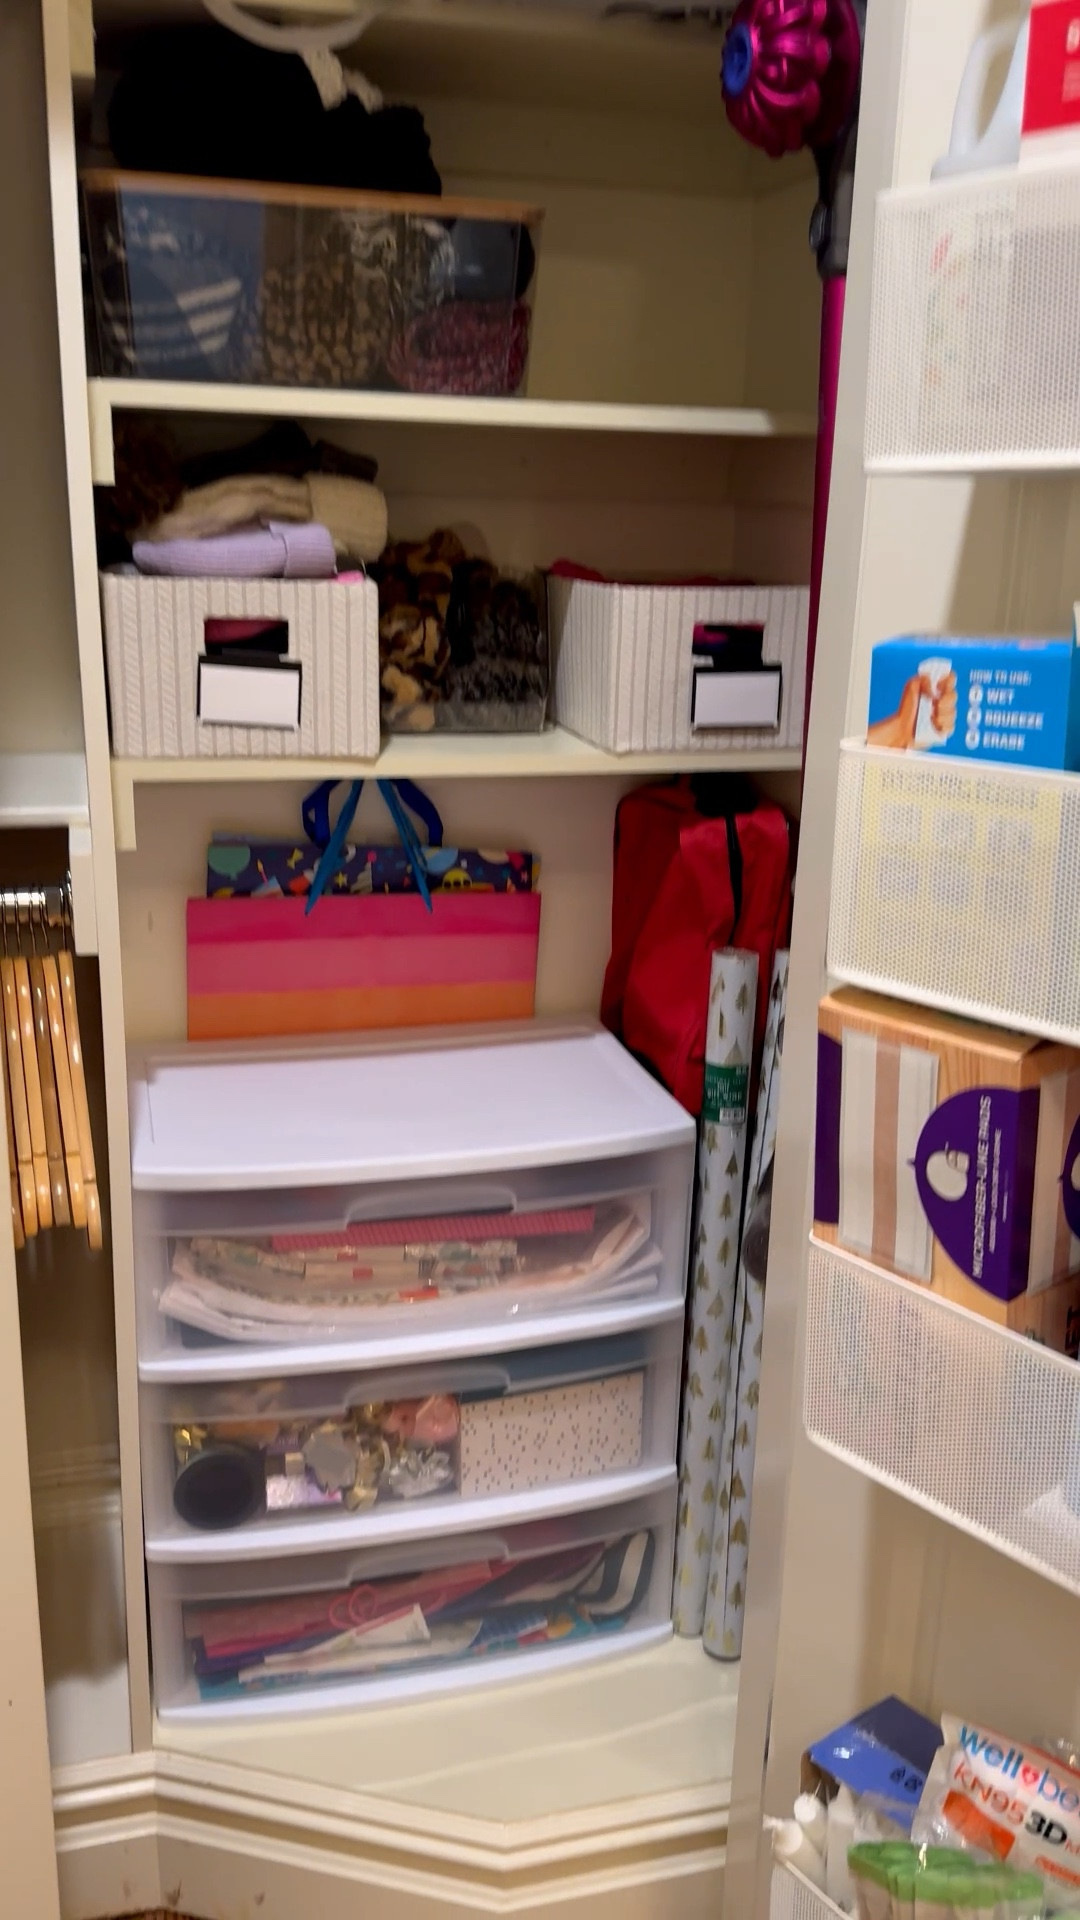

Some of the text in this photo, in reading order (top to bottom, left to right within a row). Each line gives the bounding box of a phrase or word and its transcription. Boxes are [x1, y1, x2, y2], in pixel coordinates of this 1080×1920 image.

[969, 669, 992, 684] HOW
[995, 669, 1007, 685] TO
[986, 688, 1014, 705] WET
[984, 709, 1044, 730] SQUEEZE
[983, 732, 1026, 751] ERASE
[954, 1762, 1027, 1826] KN95
[1025, 1809, 1067, 1845] 3D
